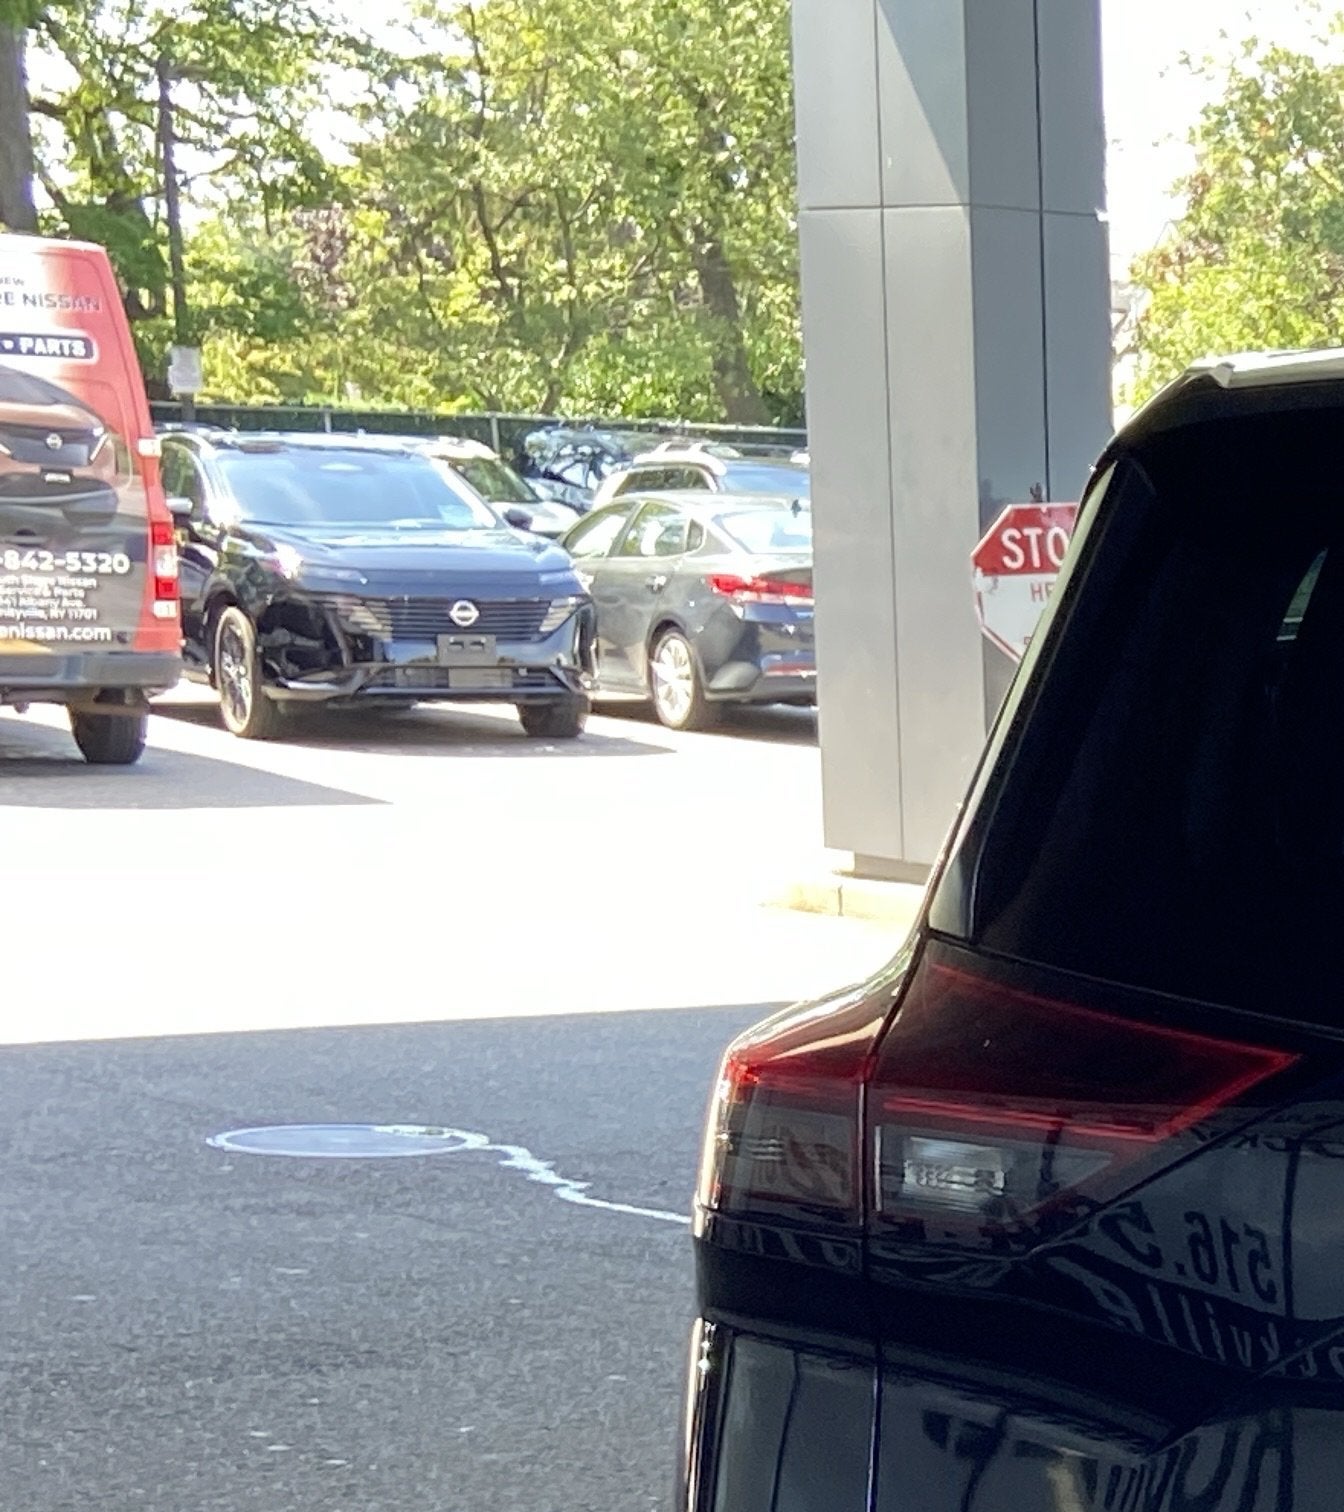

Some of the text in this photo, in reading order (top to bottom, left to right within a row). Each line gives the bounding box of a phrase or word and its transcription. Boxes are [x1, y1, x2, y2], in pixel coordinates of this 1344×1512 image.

[22, 292, 101, 312] NISSAN
[19, 336, 86, 358] PARTS
[1001, 526, 1070, 569] STO
[0, 549, 131, 574] 842-5320
